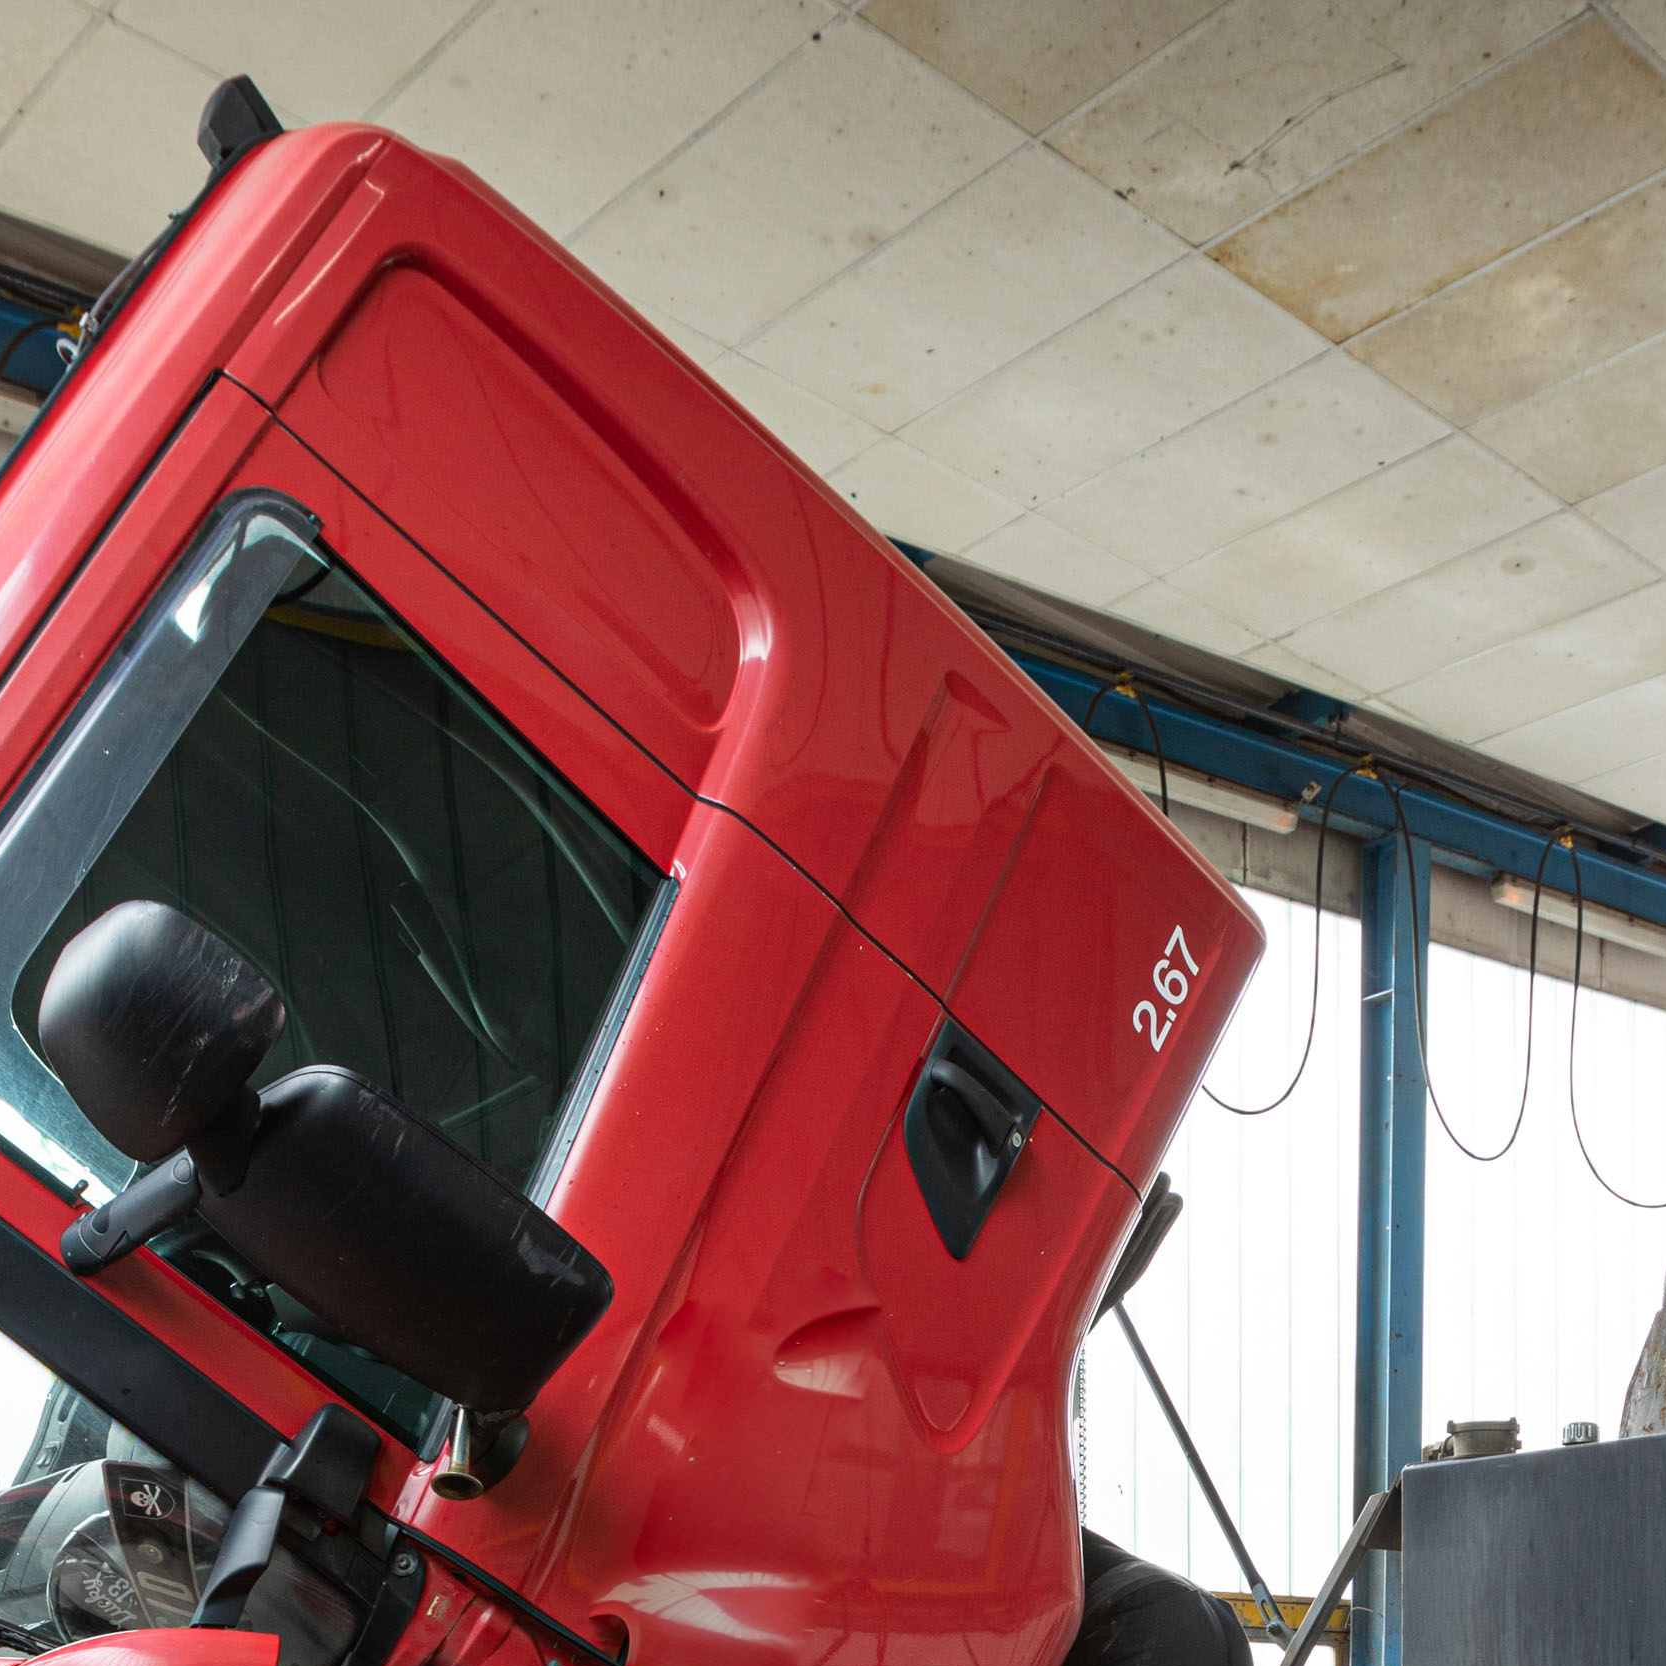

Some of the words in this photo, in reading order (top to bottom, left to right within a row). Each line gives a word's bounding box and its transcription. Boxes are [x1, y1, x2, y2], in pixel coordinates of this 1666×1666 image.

[1132, 924, 1199, 1053] 2.67
[83, 1571, 137, 1629] Lucky
[108, 1577, 135, 1602] 13
